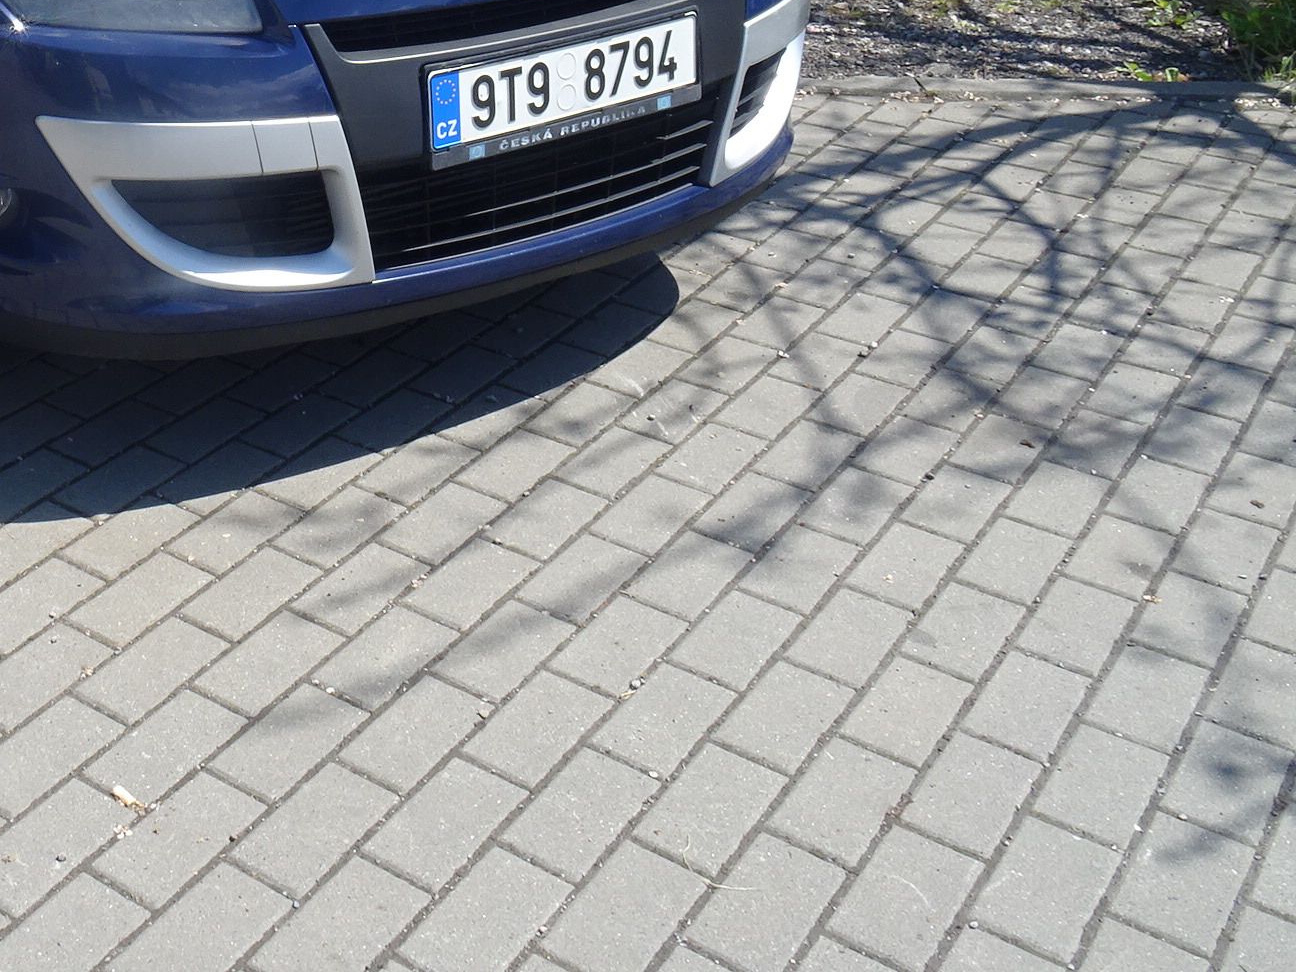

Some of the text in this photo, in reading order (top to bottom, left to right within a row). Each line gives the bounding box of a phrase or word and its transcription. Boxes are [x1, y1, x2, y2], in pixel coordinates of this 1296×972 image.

[471, 29, 678, 130] 9T9 8794
[436, 118, 458, 140] CZ
[498, 128, 554, 151] ČESKÁ
